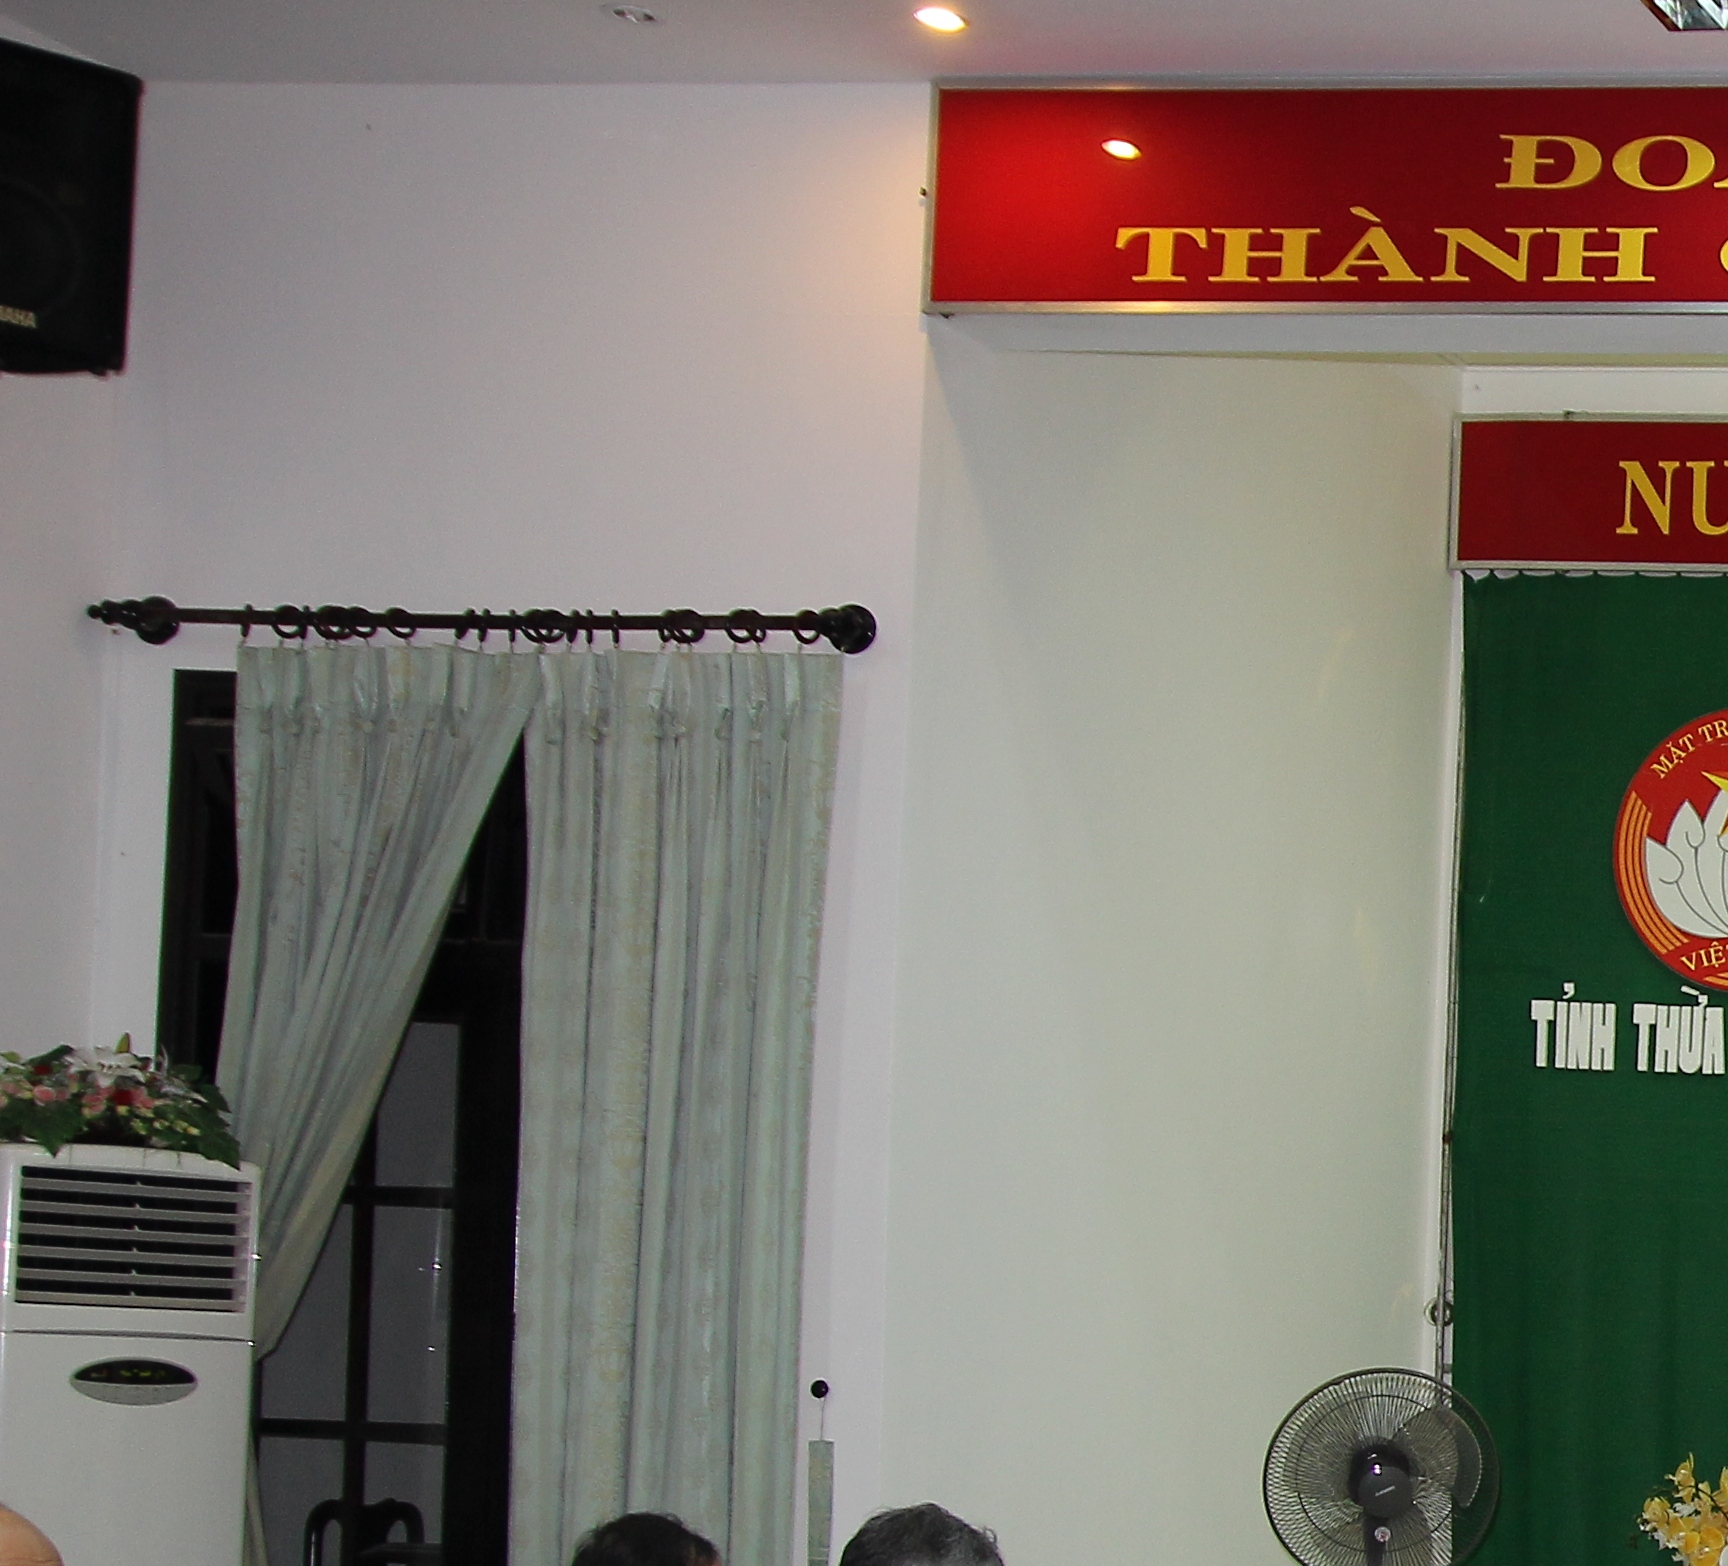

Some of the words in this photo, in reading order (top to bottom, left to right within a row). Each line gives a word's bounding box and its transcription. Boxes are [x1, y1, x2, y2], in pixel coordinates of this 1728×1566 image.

[1116, 207, 1658, 281] THÀNH
[1650, 734, 1695, 778] MẶT
[1531, 983, 1615, 1070] TỈNH
